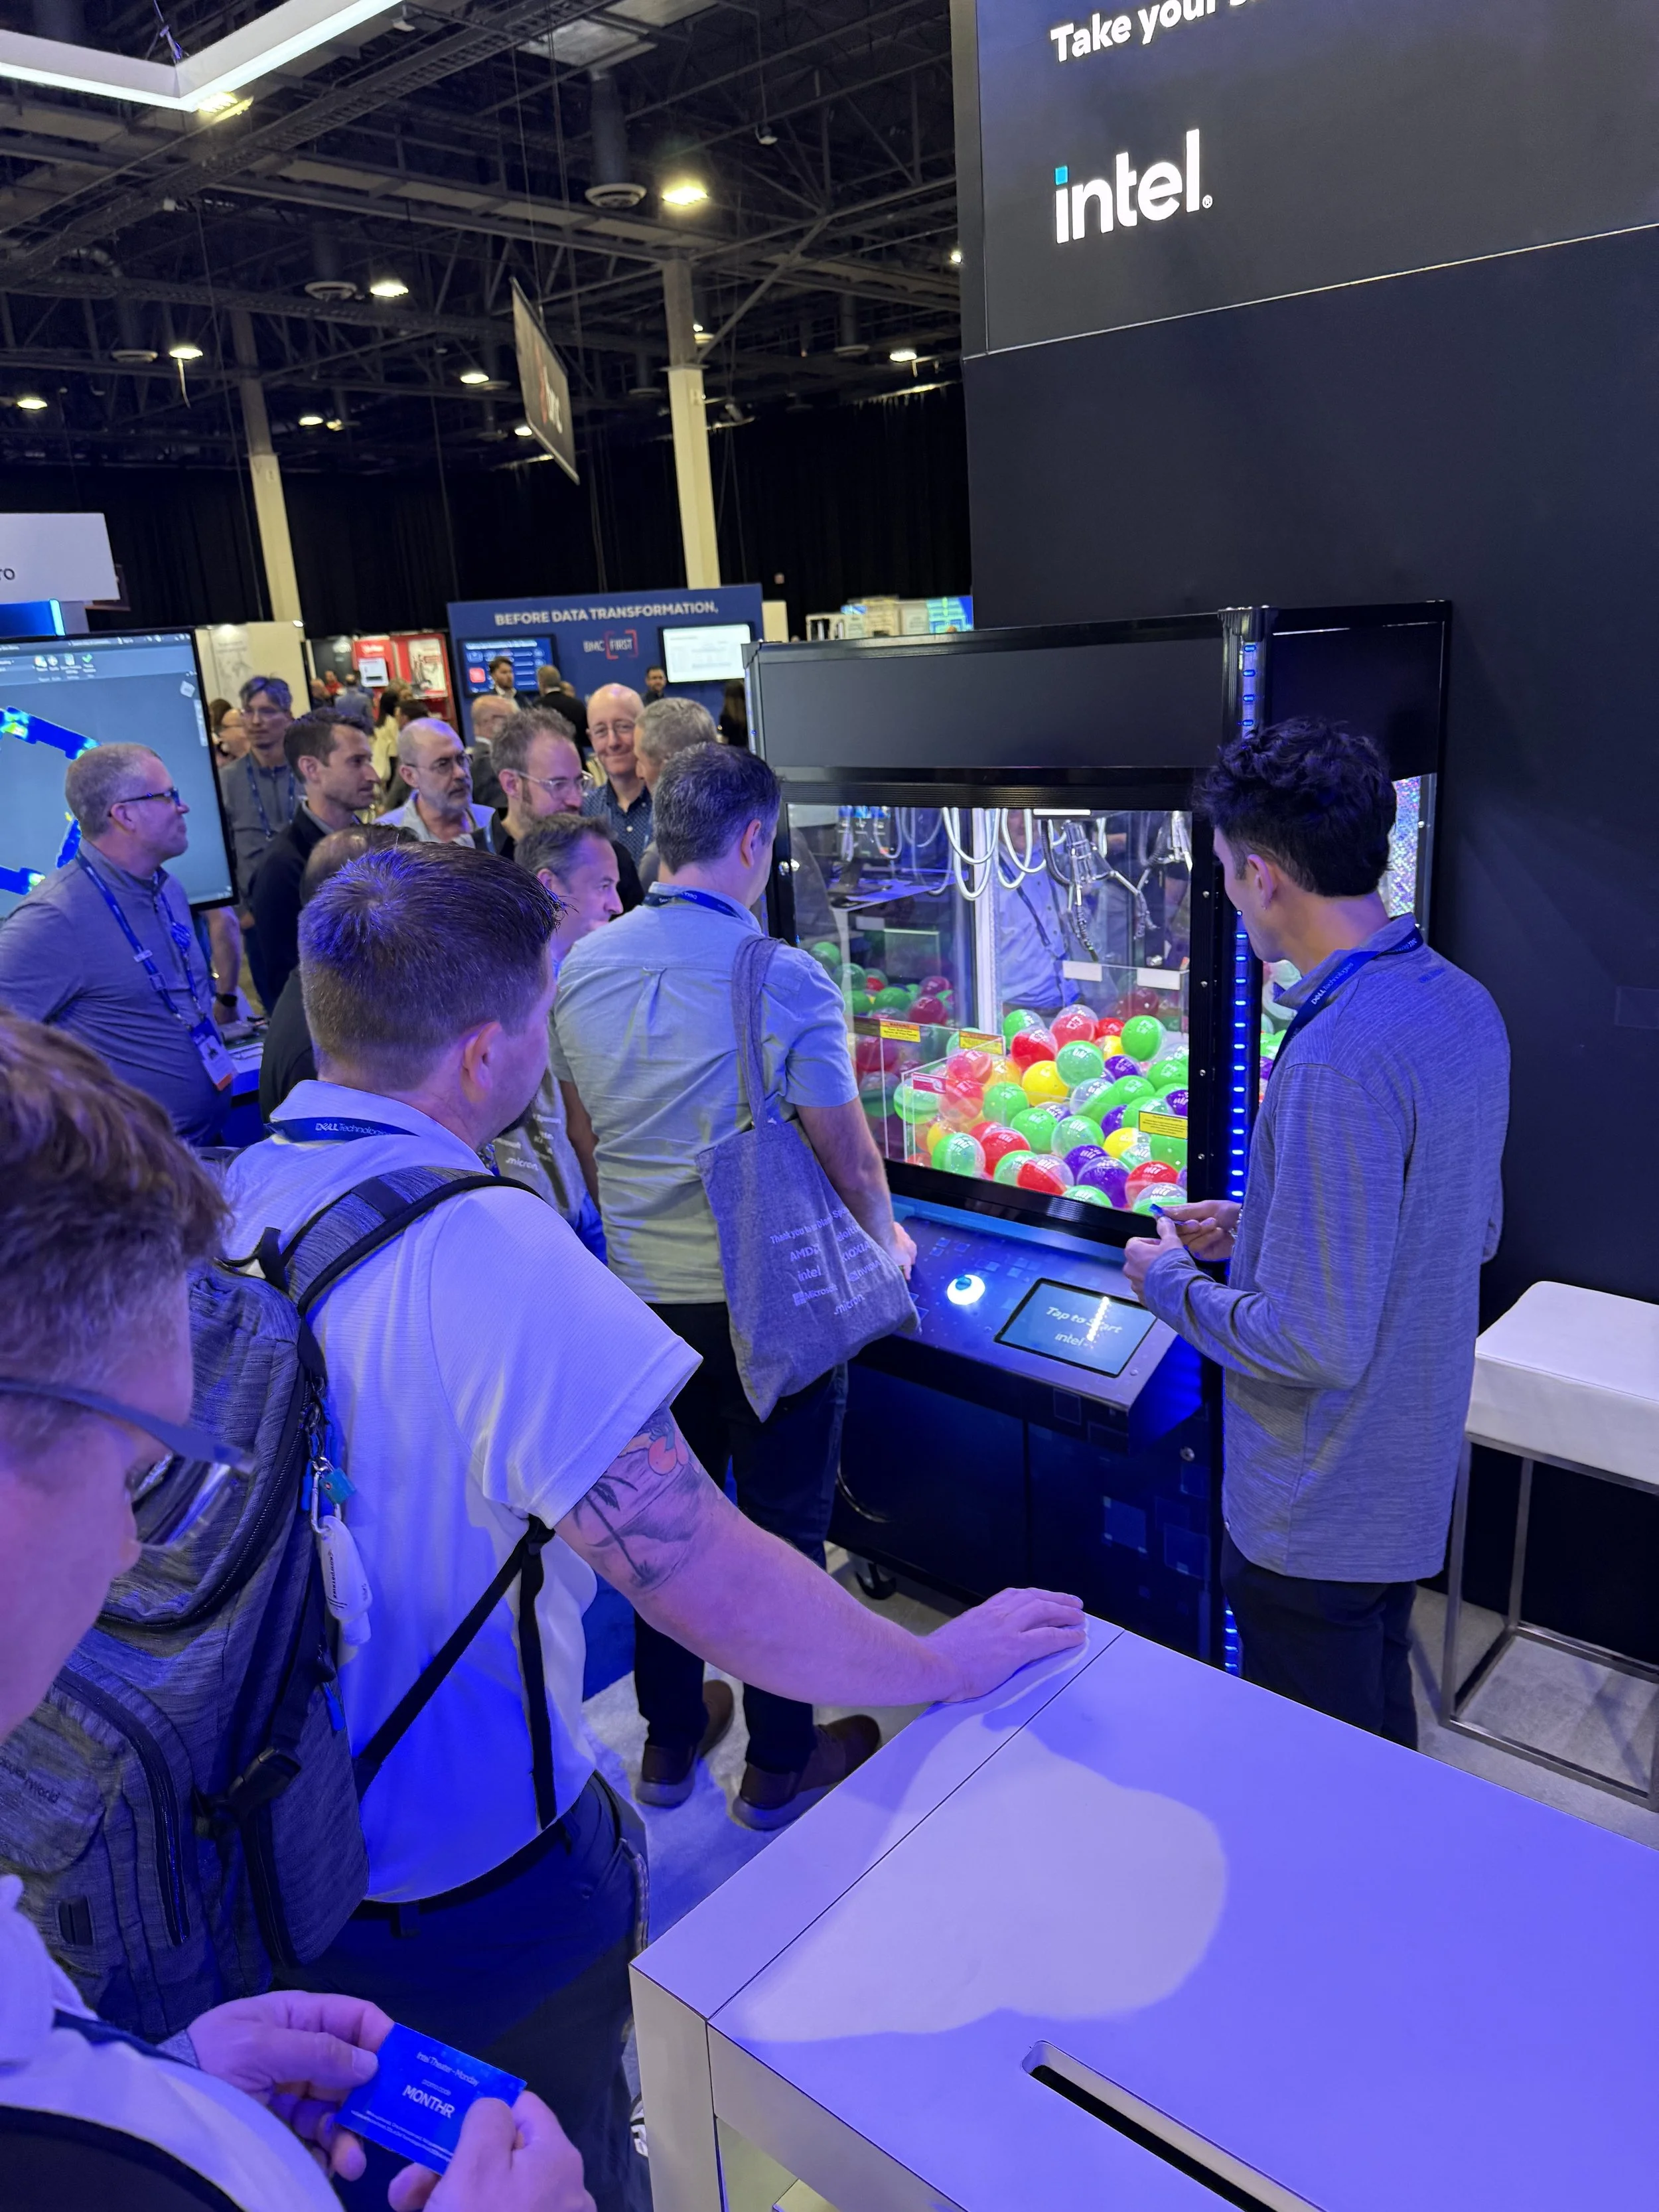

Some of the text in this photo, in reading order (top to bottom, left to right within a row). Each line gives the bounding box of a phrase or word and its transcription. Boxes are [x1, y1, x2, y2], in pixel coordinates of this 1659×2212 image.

[1050, 13, 1132, 62] Take
[494, 611, 550, 627] BEFORE
[551, 607, 589, 623] DATA
[583, 637, 635, 653] BMC FIRST
[315, 1122, 339, 1132] DELL
[797, 1264, 822, 1282] intel
[1046, 1306, 1070, 1320] Tap
[1070, 1314, 1086, 1323] to
[401, 2084, 456, 2119] MONTHR
